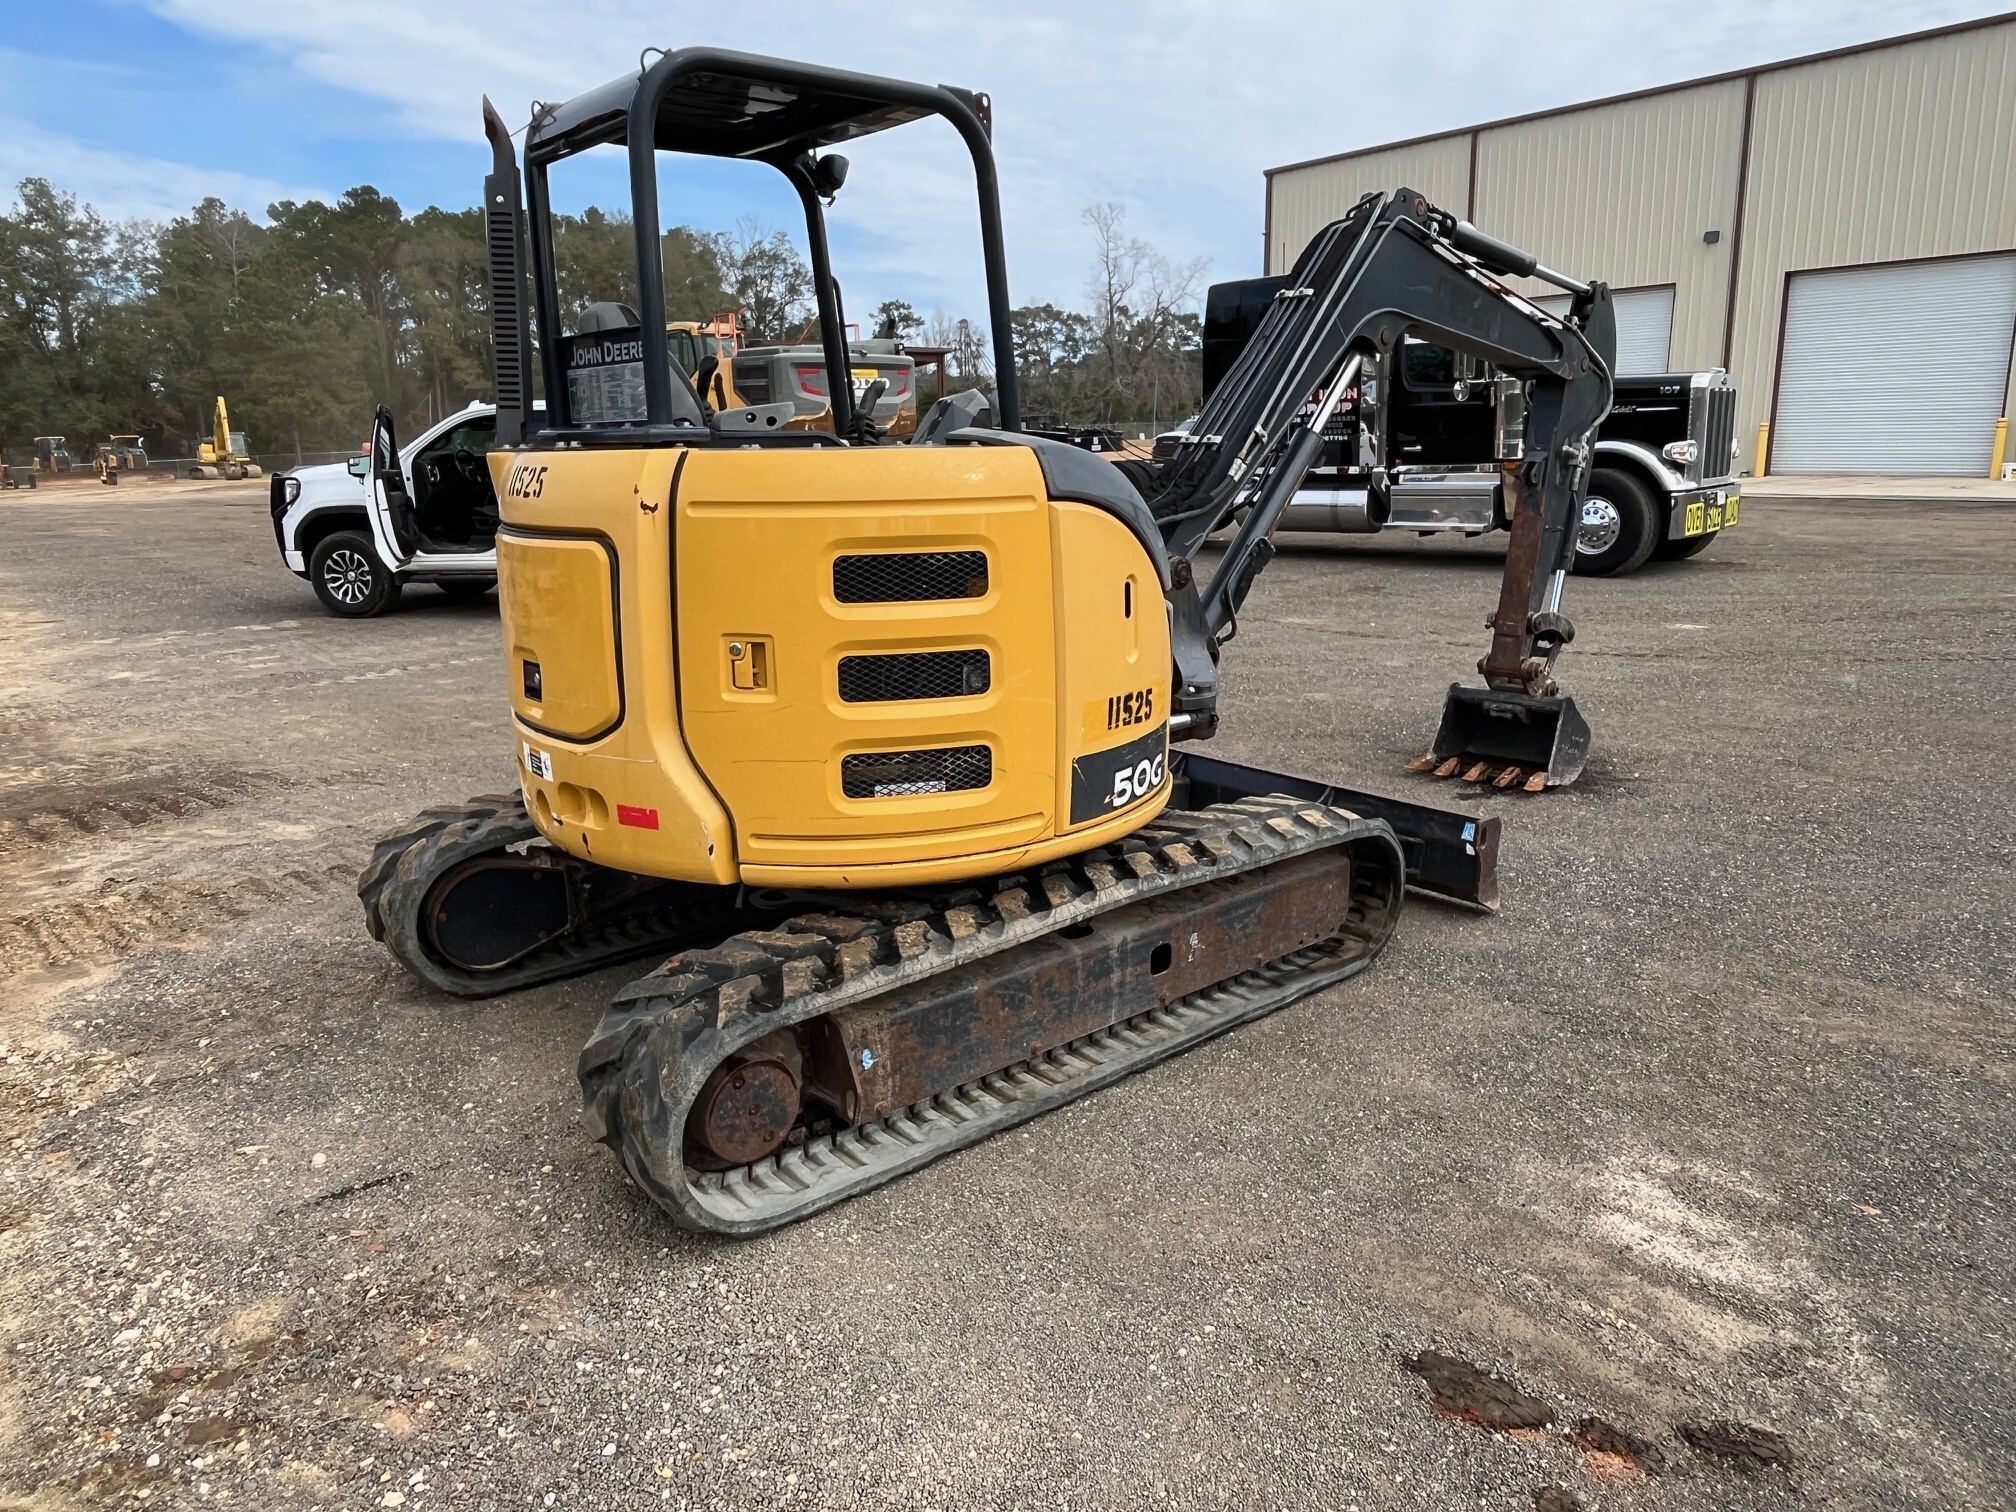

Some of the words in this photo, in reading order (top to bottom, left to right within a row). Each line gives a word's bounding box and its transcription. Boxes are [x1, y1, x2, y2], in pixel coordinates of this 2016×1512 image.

[571, 346, 602, 366] JOHN
[508, 466, 548, 498] 11525
[1108, 688, 1152, 730] 11525
[1112, 753, 1163, 807] 50G
